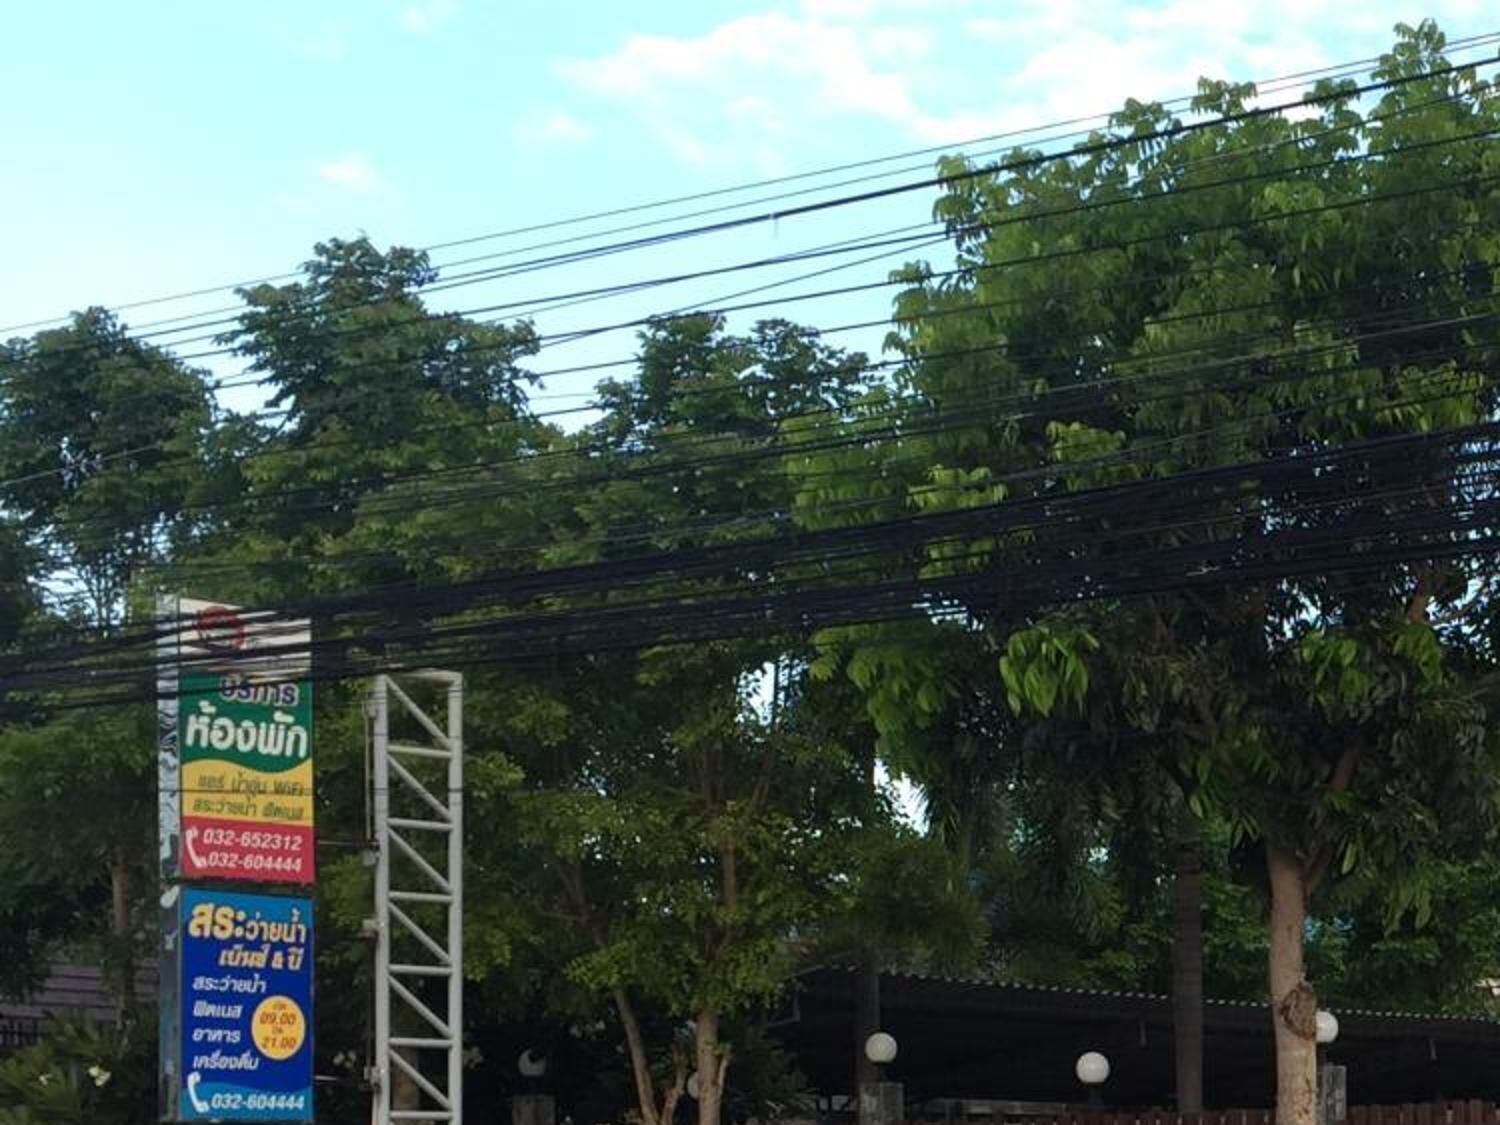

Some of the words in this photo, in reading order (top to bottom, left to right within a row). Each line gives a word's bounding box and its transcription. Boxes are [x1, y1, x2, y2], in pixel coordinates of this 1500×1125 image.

[185, 700, 308, 758] ห้องพัก
[203, 827, 302, 850] 032-652312
[208, 853, 302, 872] 032-604444
[188, 902, 306, 944] สระว่ายน้ำ
[192, 972, 267, 994] สระว่ายน้ำ
[259, 1010, 297, 1026] 09.00
[192, 1027, 241, 1043] อาหาร
[211, 1092, 305, 1111] 032-604444
